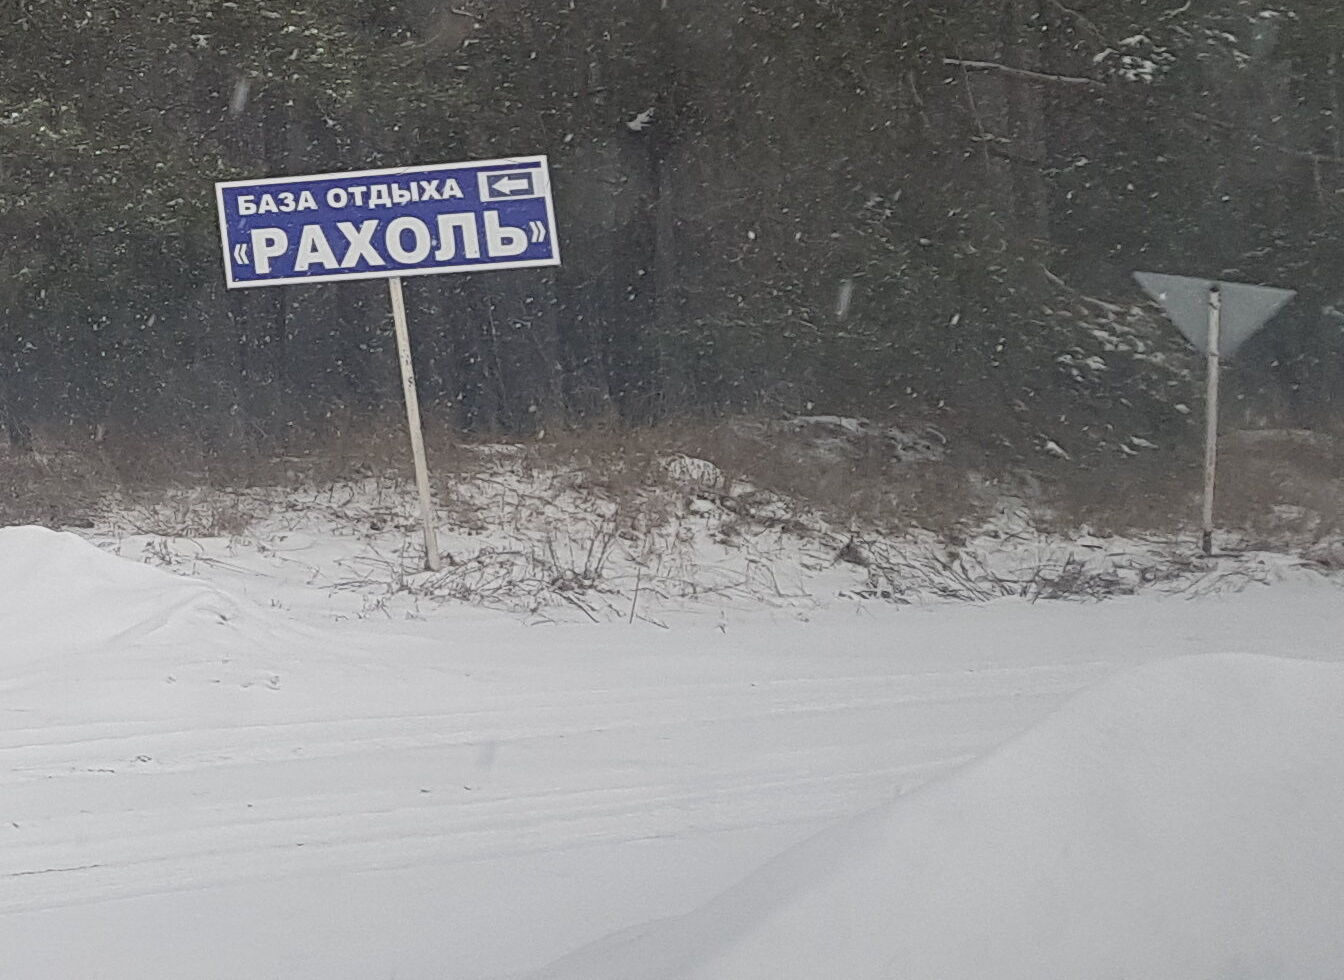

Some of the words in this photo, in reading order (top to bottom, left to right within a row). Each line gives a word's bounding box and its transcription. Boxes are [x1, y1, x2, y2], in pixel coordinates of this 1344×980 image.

[237, 190, 318, 215] БАЗА
[326, 178, 464, 208] ОТДЫХА
[233, 210, 547, 274] «РАХОЛЬ»
